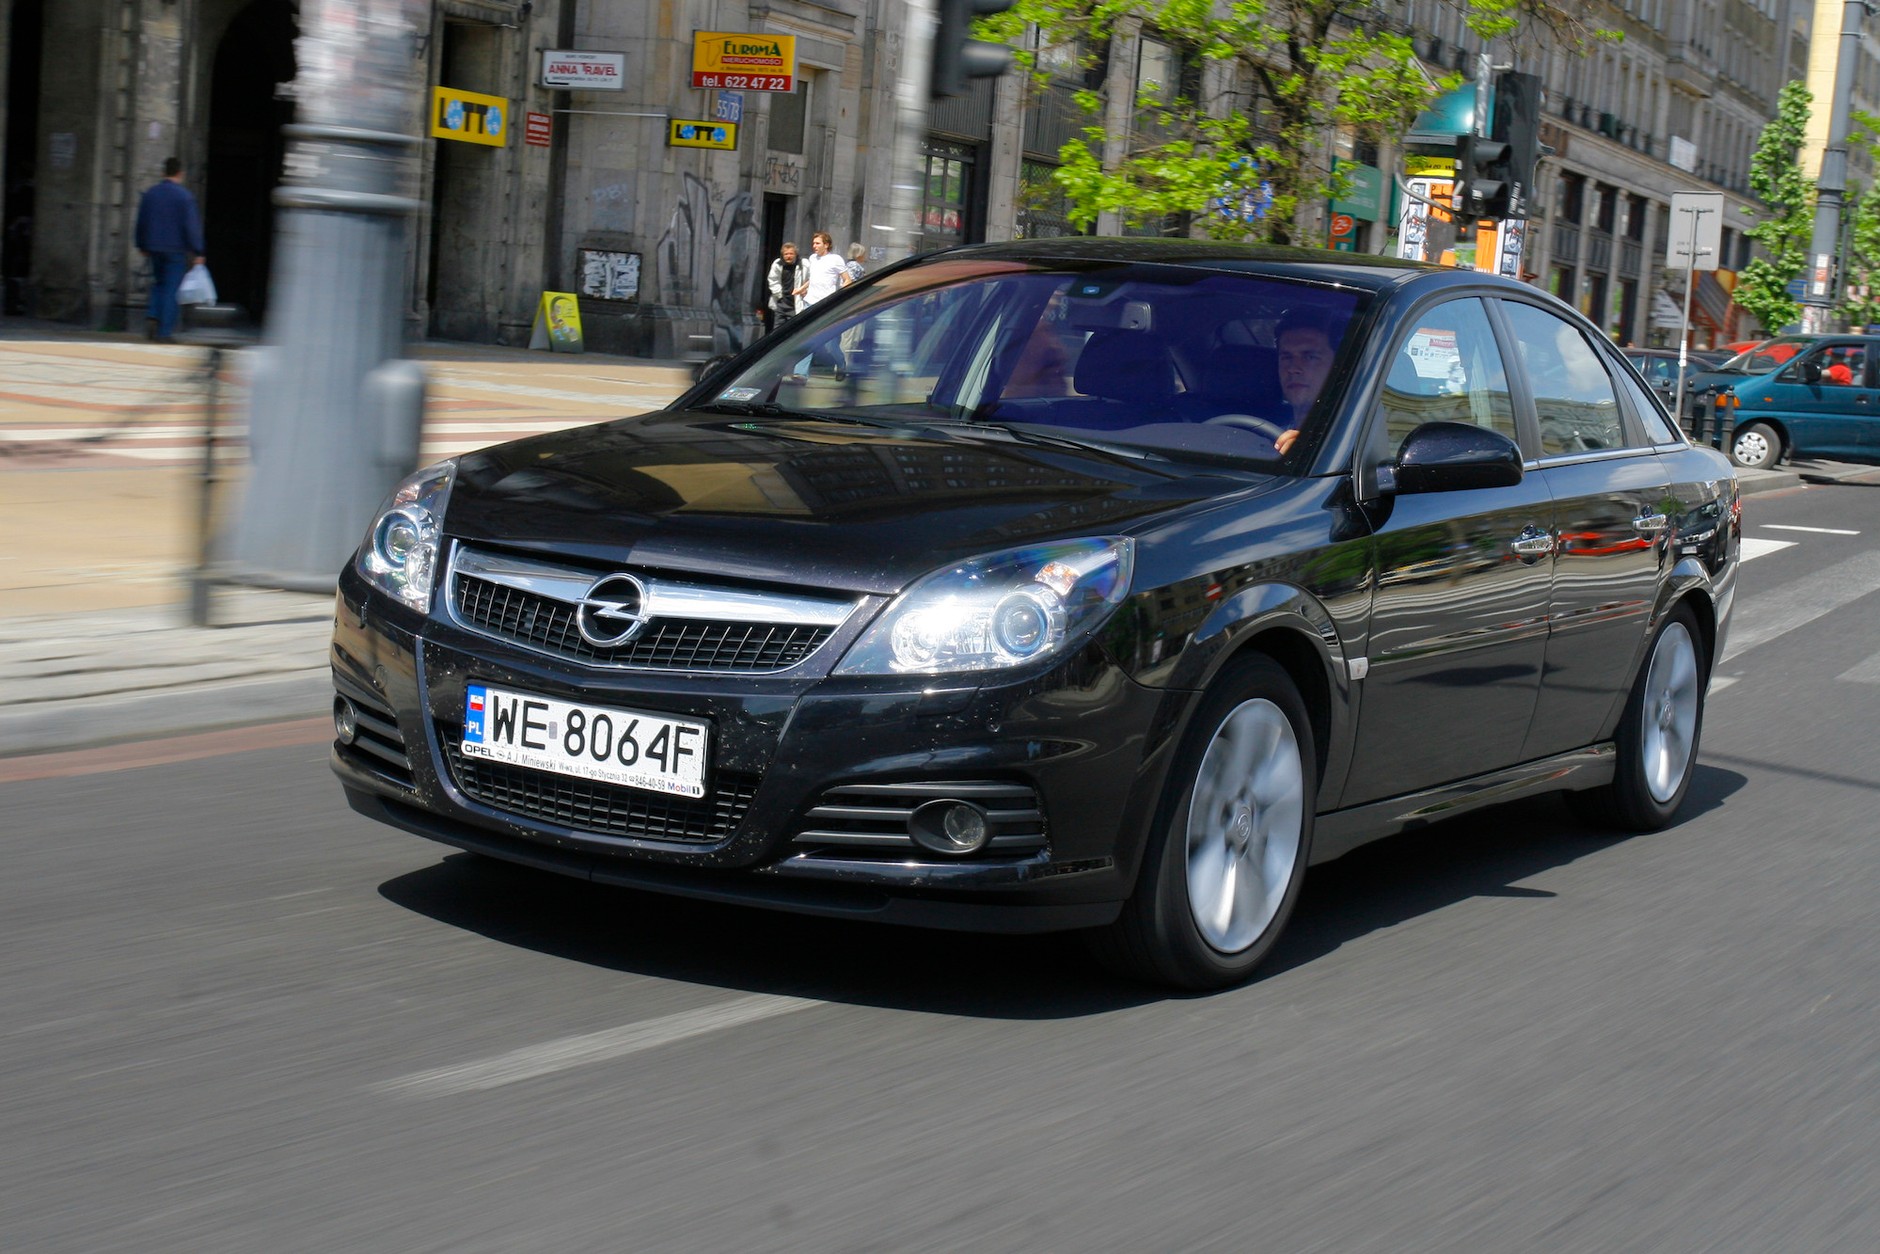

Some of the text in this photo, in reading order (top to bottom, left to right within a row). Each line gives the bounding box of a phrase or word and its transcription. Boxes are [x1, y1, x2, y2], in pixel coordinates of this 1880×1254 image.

[549, 62, 618, 77] ANNA TRAVEL
[702, 75, 785, 90] tel. 622 47 22
[439, 97, 503, 136] LOTTO
[676, 123, 726, 142] LOTTO
[468, 721, 482, 736] PL
[492, 695, 700, 774] WE 8064F
[464, 744, 495, 758] OPEL
[522, 754, 556, 770] Miniewski
[667, 782, 691, 794] Mobil
